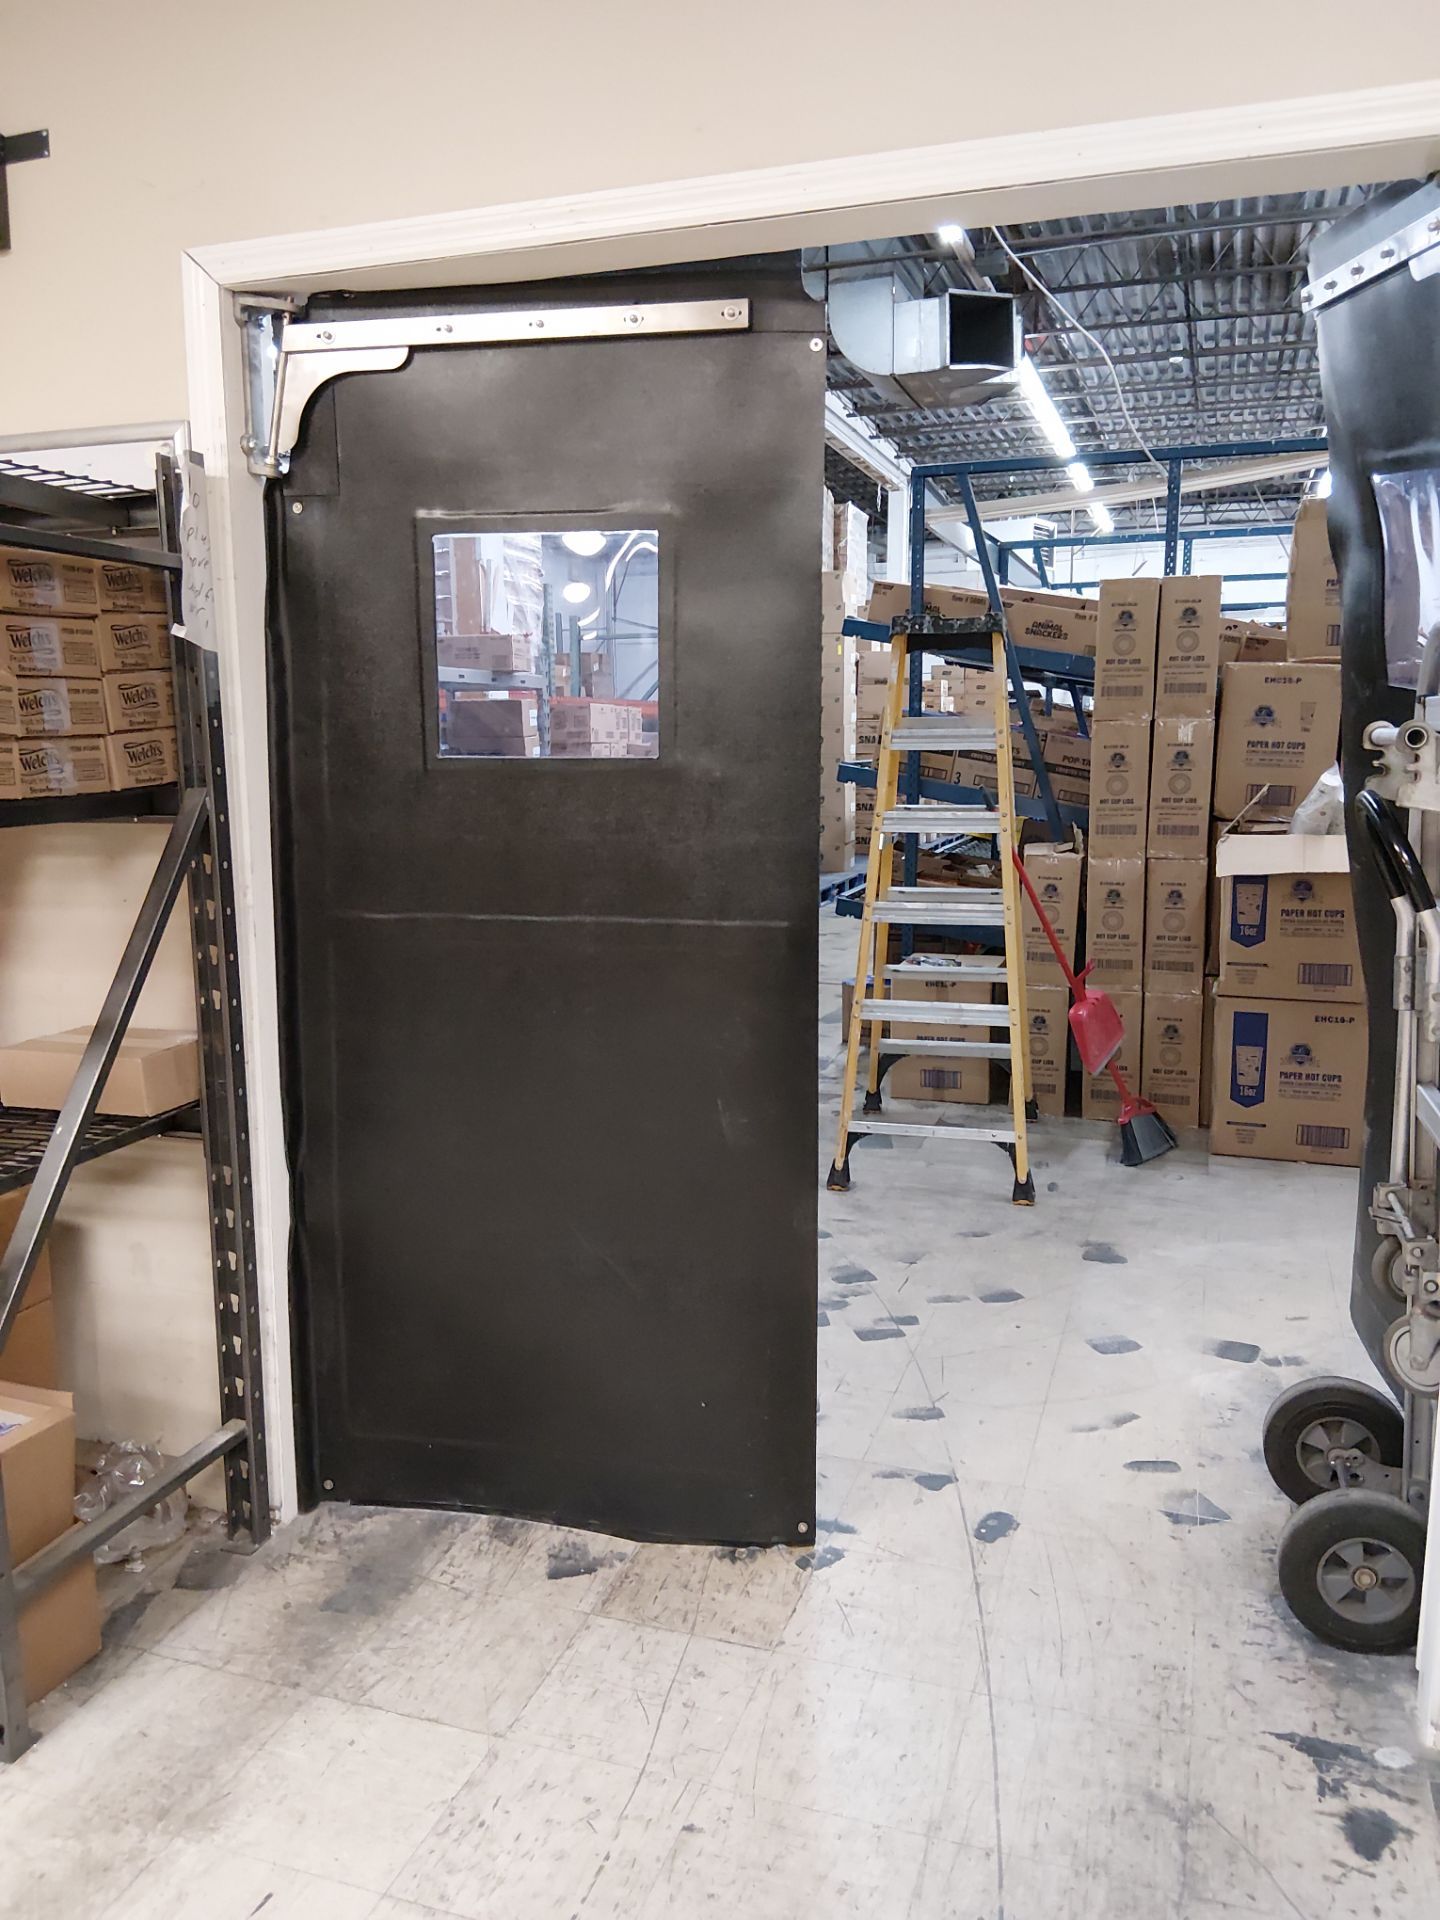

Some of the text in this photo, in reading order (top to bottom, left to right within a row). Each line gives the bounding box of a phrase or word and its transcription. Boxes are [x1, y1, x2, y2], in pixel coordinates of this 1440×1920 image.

[1031, 621, 1063, 633] ANIMAL
[114, 628, 149, 646] Welch's
[1025, 627, 1069, 640] SNACKERS
[121, 687, 157, 705] Welch's
[1247, 740, 1306, 750] PAPER HOT CUPS
[127, 743, 163, 764] Welch's
[953, 771, 961, 784] 3
[1280, 909, 1345, 918] PAPER HOT CUPS
[1239, 925, 1258, 936] 16oz
[1279, 1071, 1342, 1082] PAPER HOT CUPS
[1239, 1086, 1257, 1097] 16oz
